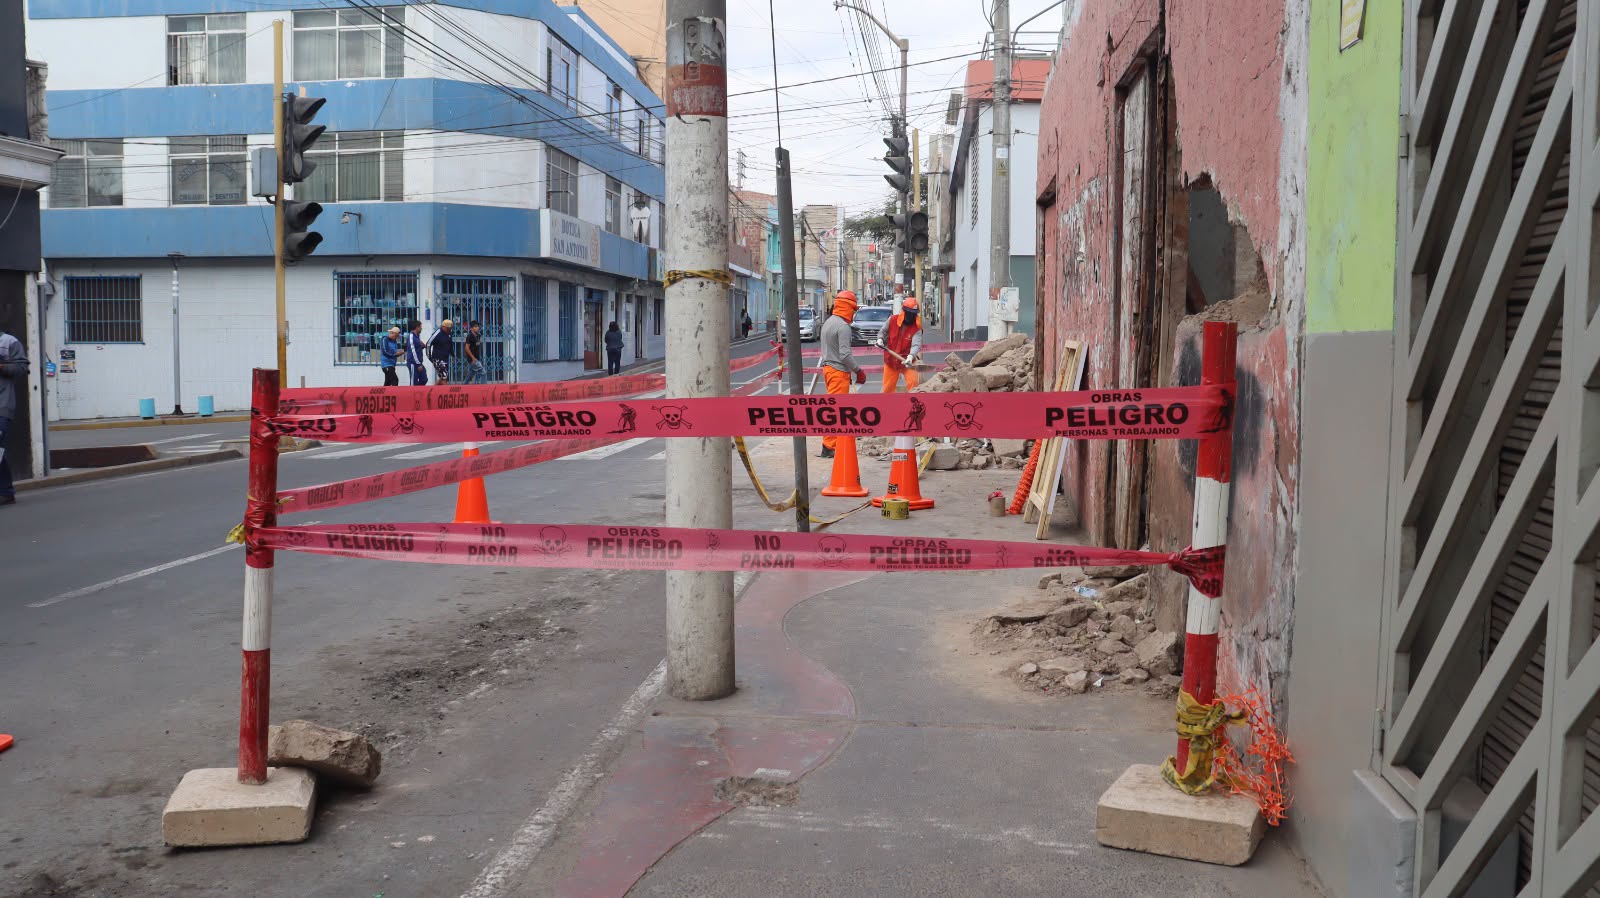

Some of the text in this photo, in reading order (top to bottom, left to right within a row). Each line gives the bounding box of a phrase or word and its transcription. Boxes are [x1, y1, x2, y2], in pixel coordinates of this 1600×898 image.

[553, 237, 588, 260] SAN ANTONIO
[788, 397, 837, 406] OBRAS
[1091, 392, 1142, 403] OBRAS
[472, 410, 597, 429] PELIGRO
[748, 406, 881, 427] PELIGRO
[1045, 402, 1189, 427] PELIGRO
[485, 429, 592, 438] PERSONAS TRABAJANDO
[1055, 427, 1180, 437] PERSONAS TRABAJANDO
[348, 523, 396, 533] OBRAS
[481, 526, 506, 543] NO
[607, 527, 660, 538] OBRAS
[326, 531, 415, 552] PELIGRO
[587, 537, 683, 560] PELIGRO
[754, 534, 781, 550] NO
[892, 539, 948, 548] OBRAS
[467, 544, 518, 563] PASAR
[740, 552, 796, 569] PASAR
[869, 545, 972, 565] PELIGRO
